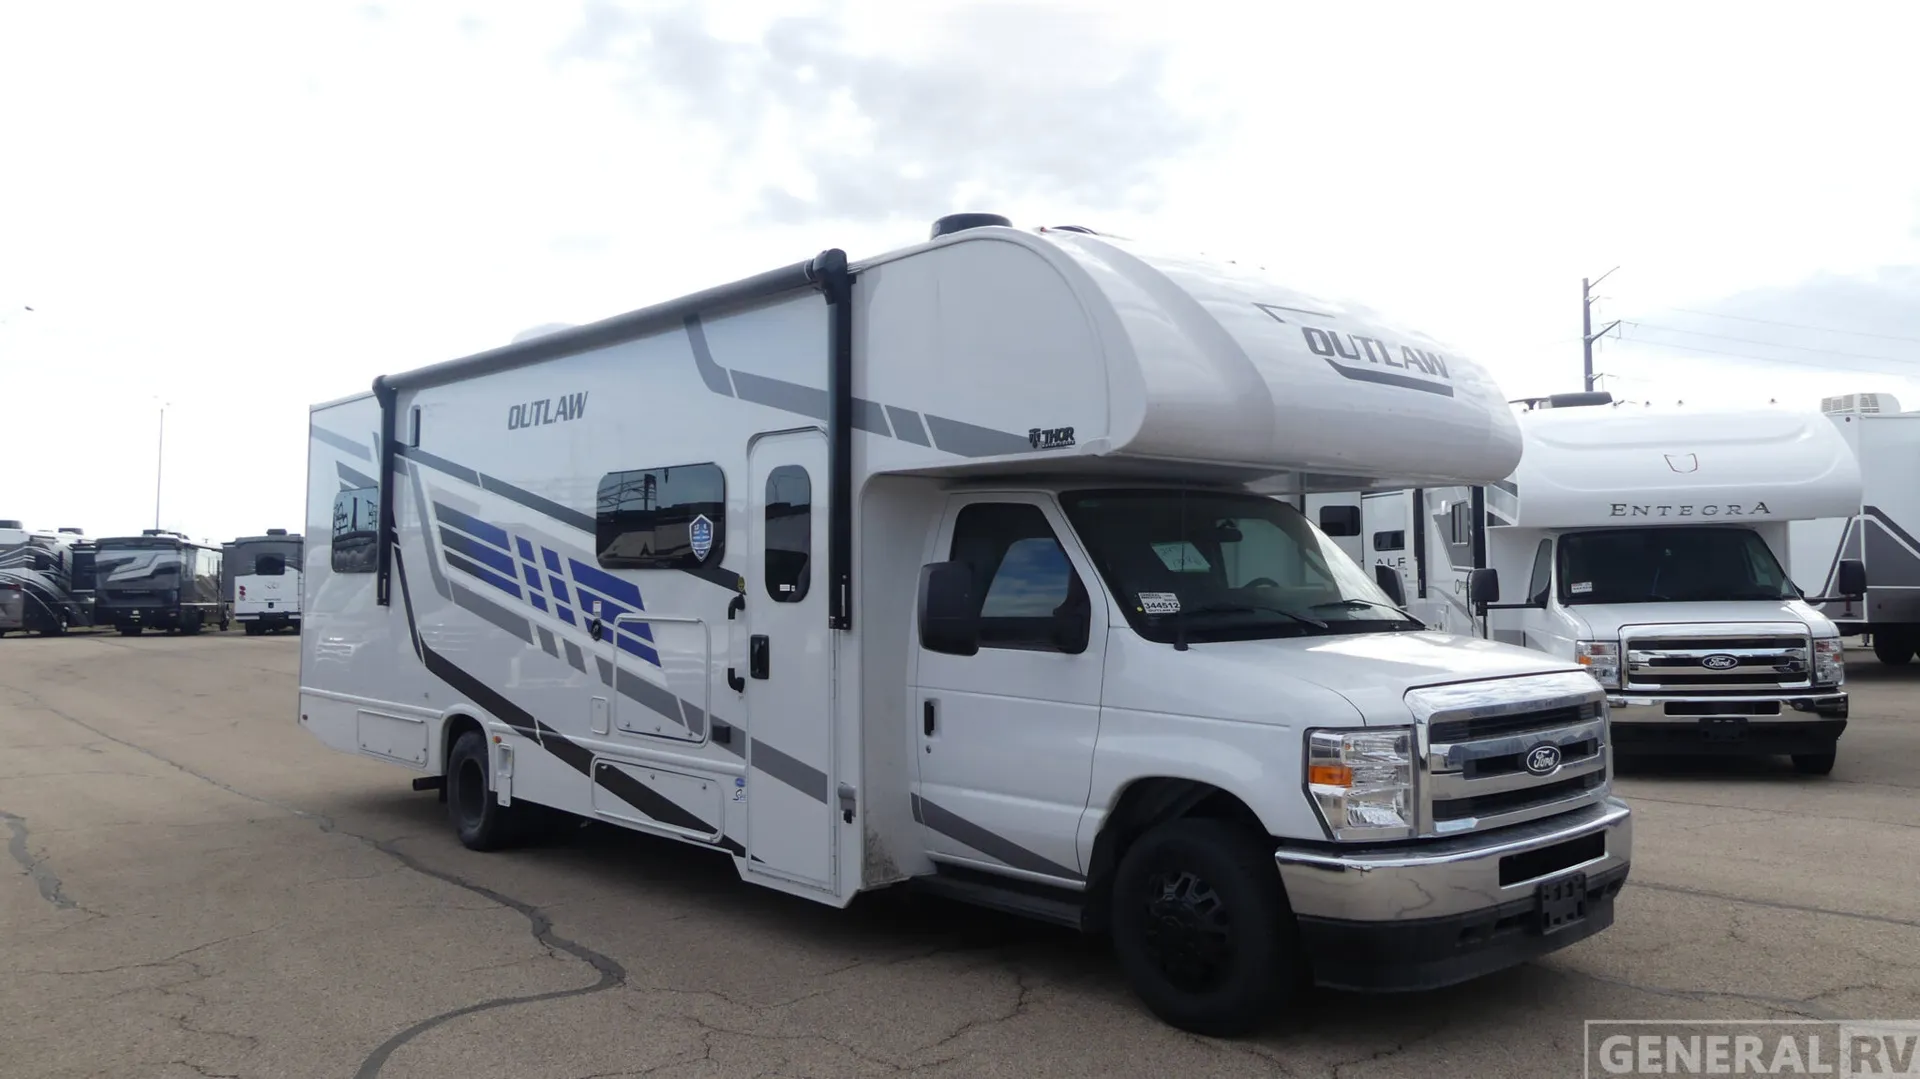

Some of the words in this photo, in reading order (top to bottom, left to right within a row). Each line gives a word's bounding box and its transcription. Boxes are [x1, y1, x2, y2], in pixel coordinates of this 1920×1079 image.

[1301, 326, 1450, 379] OUTLAW
[508, 391, 588, 430] OUTLAW
[1041, 427, 1075, 444] THOR
[1609, 501, 1771, 517] ENTEGRA
[1709, 657, 1730, 666] Ford
[1533, 750, 1555, 768] Ford
